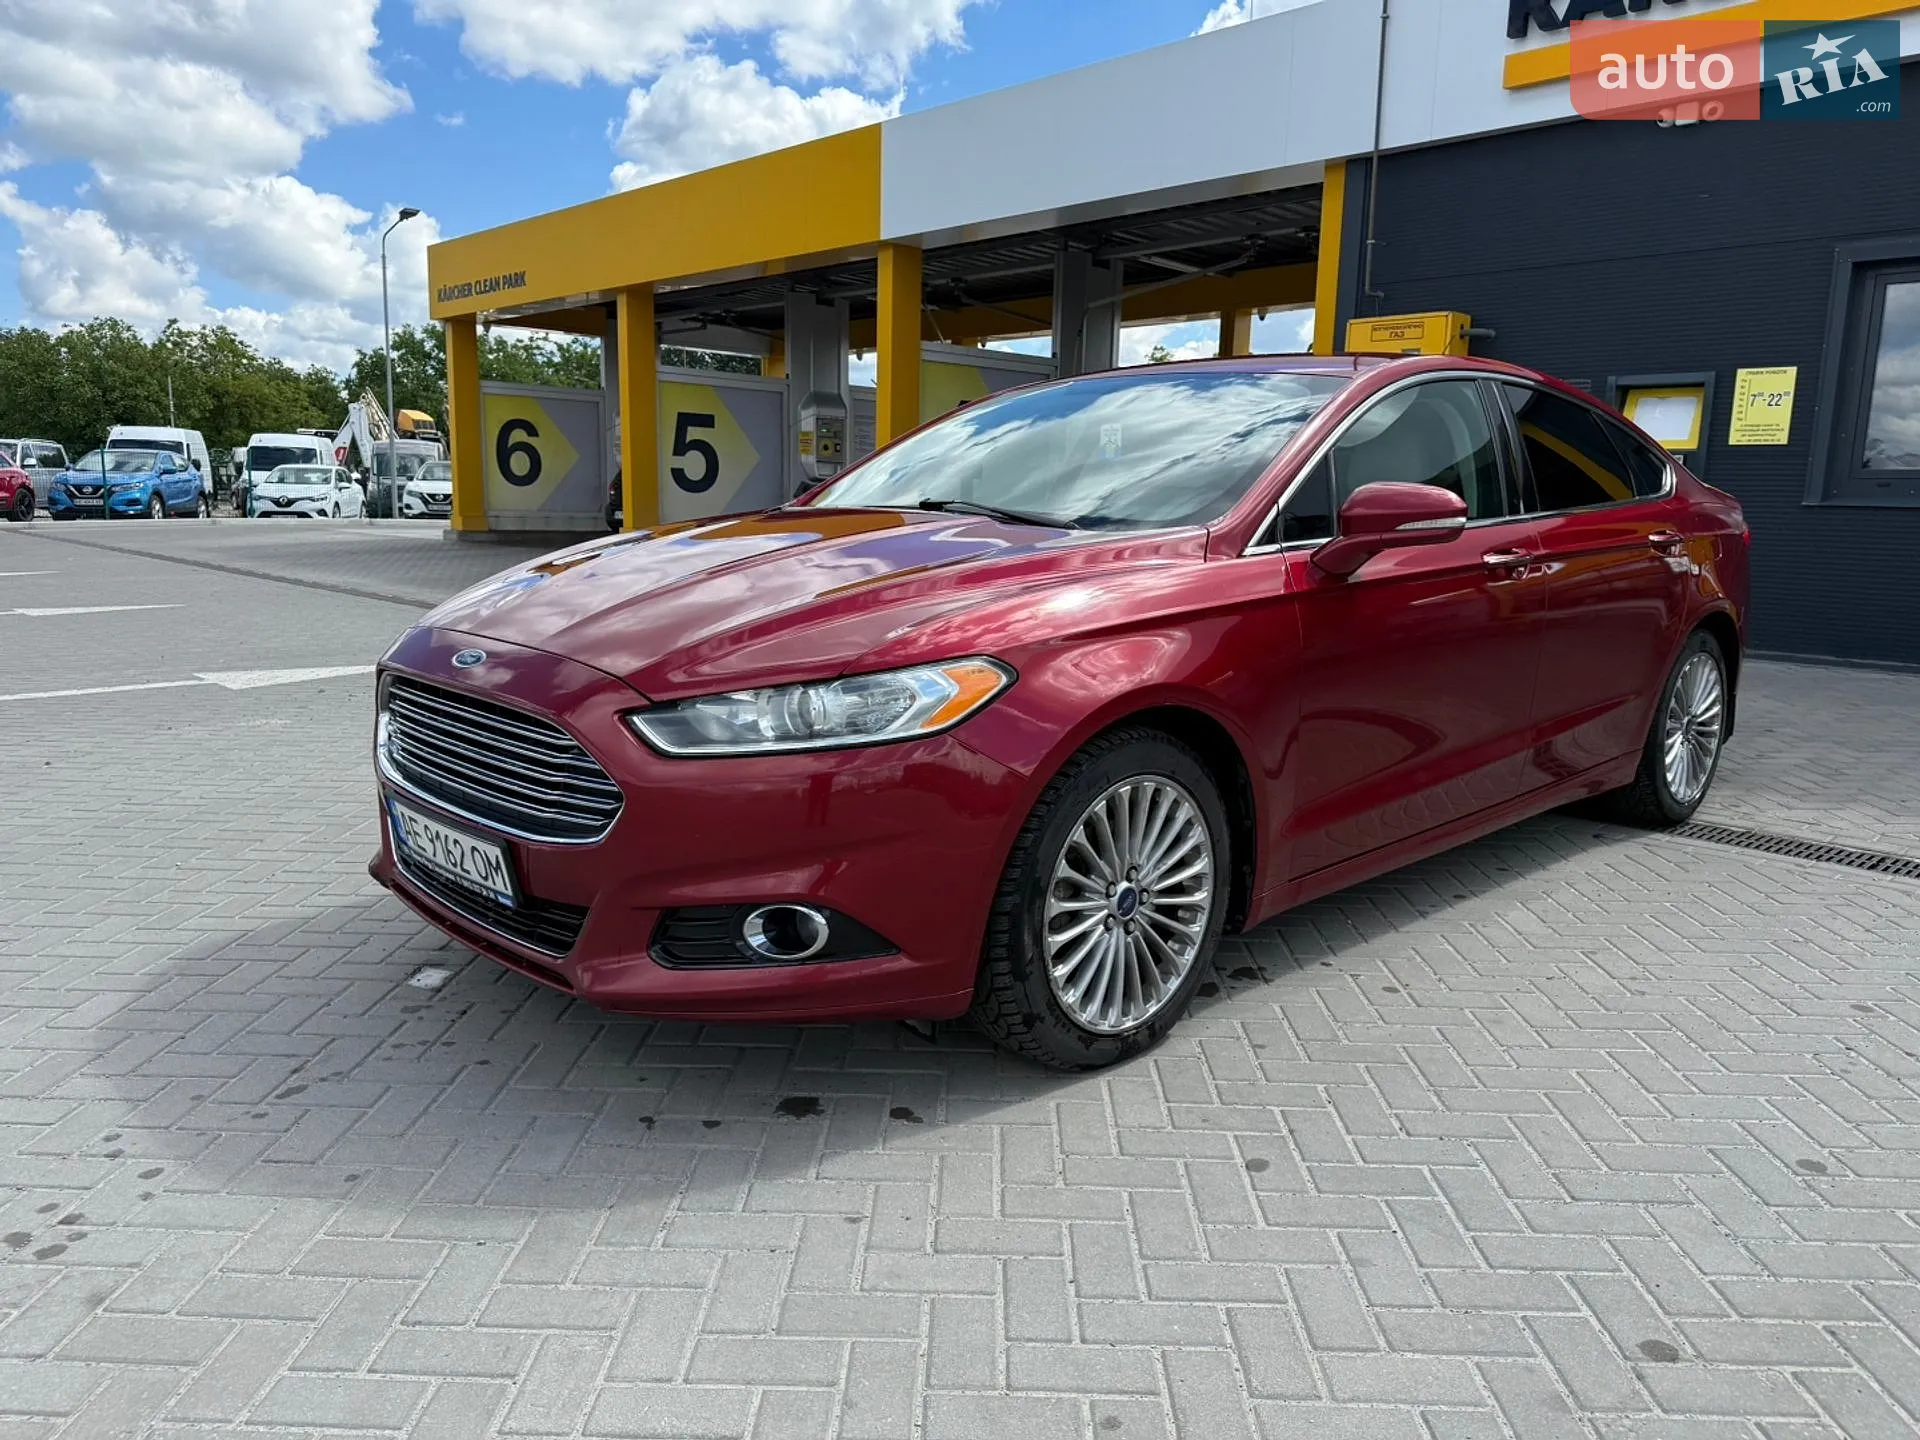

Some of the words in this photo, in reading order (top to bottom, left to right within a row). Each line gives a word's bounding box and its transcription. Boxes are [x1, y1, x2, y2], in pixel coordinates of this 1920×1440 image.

[437, 284, 473, 303] KÄRCHER
[474, 275, 501, 296] CLEAN
[502, 270, 527, 290] PARK
[495, 418, 543, 488] 6
[670, 411, 720, 493] 5
[400, 810, 428, 854] AE
[423, 823, 471, 876] 9162
[470, 844, 509, 892] OM
